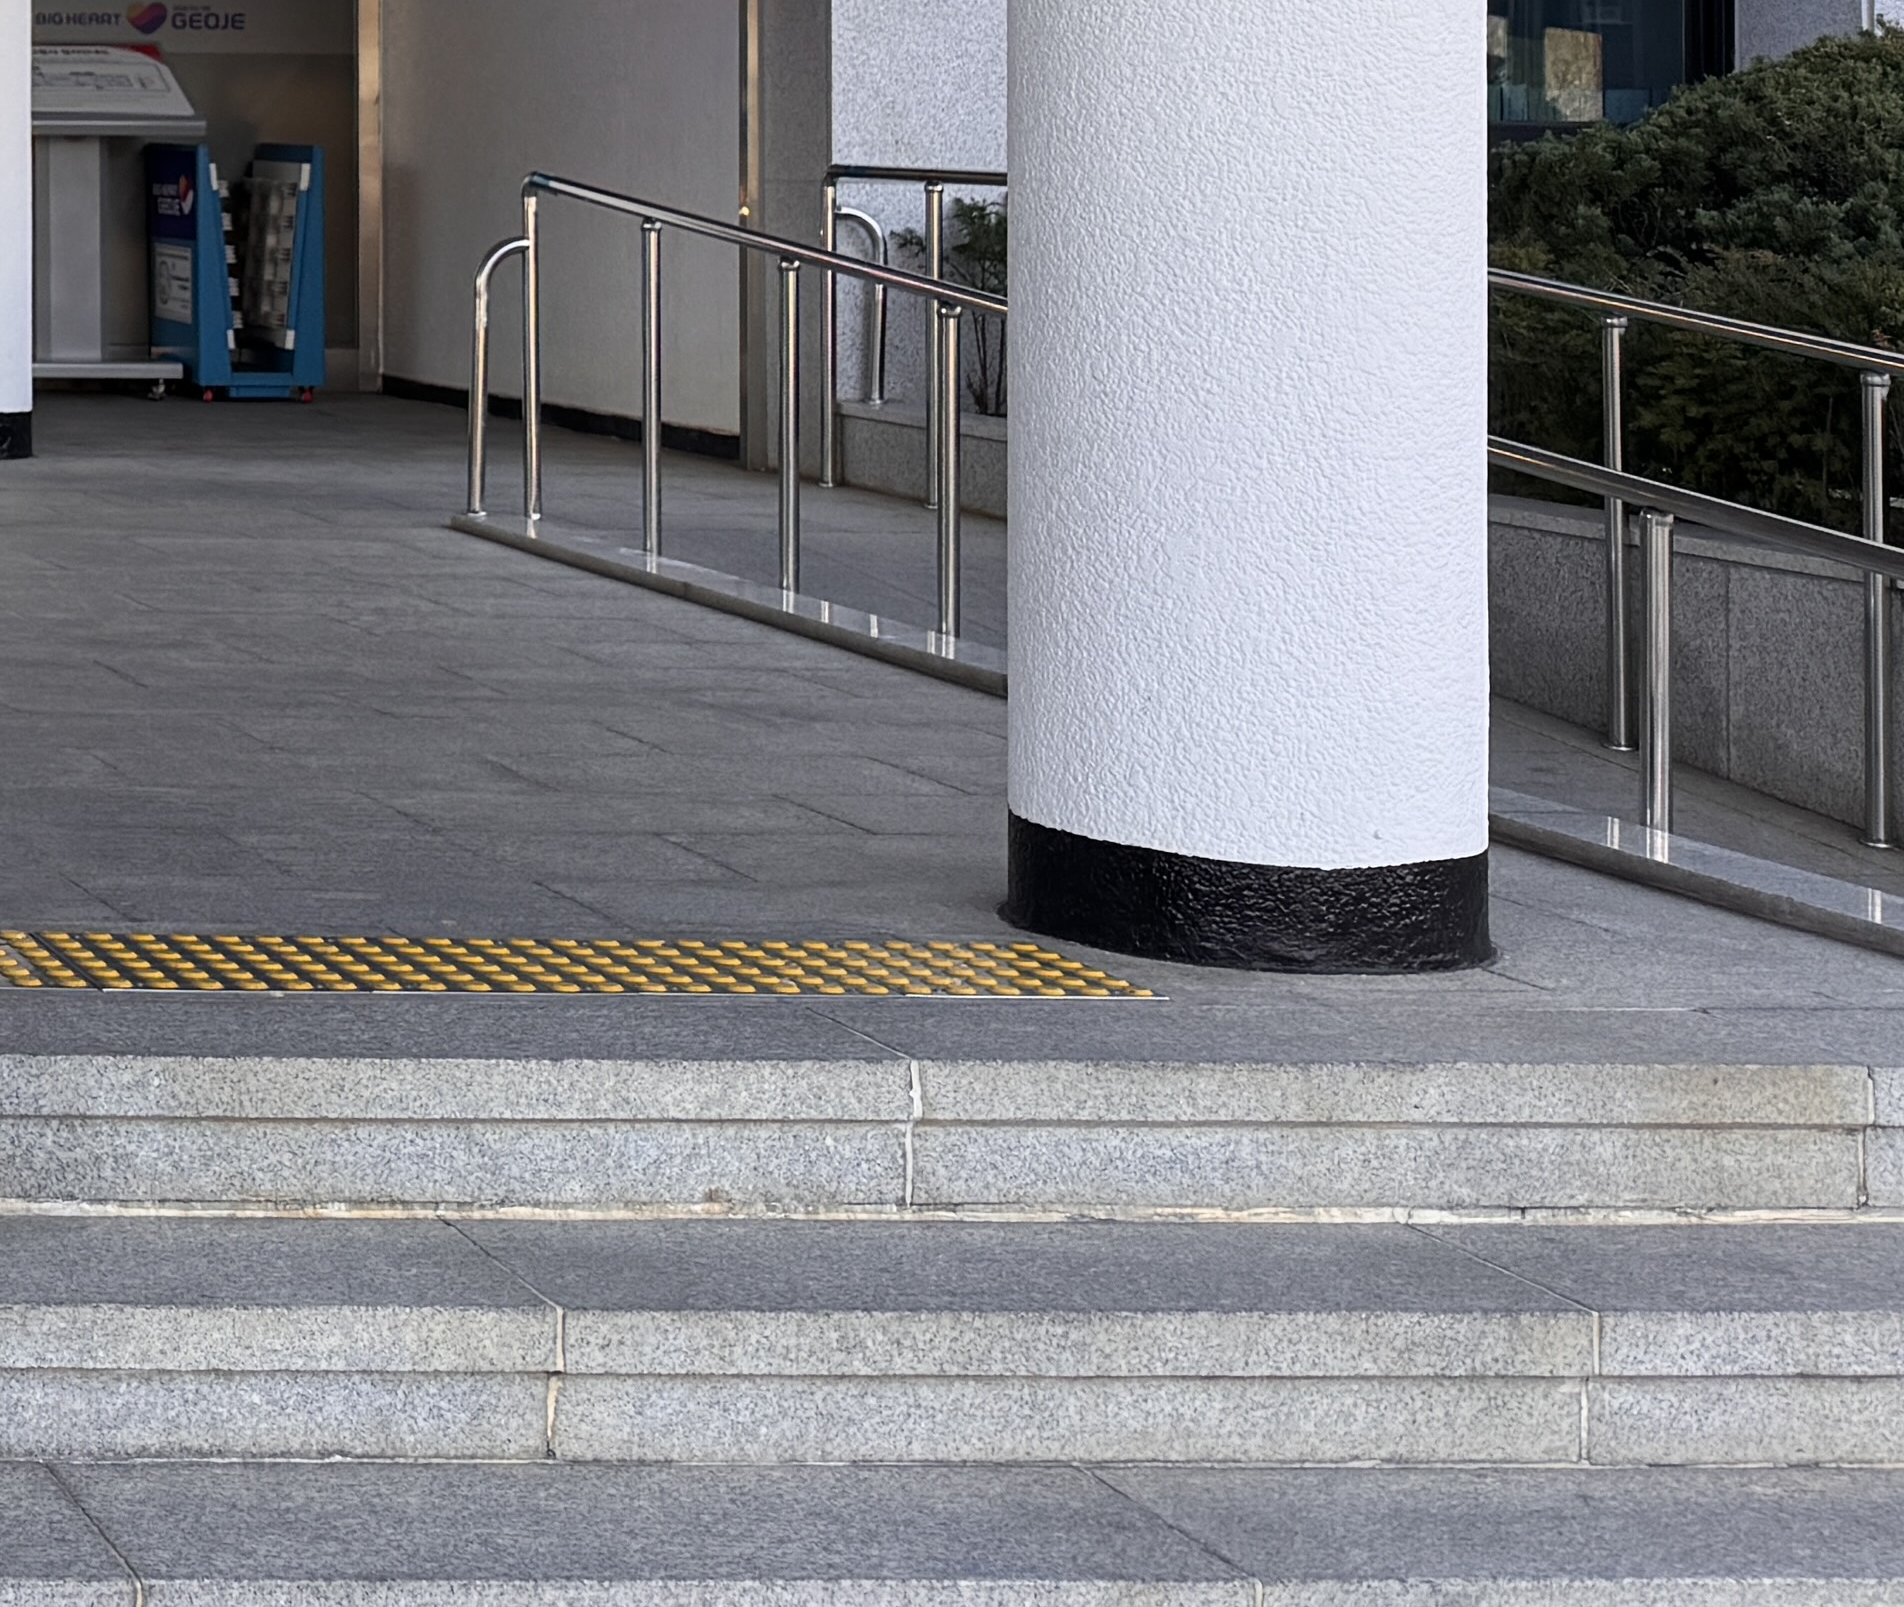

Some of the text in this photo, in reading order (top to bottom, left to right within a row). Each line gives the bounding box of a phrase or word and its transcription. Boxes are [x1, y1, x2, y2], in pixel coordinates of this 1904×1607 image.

[35, 12, 121, 26] BIG HEART
[171, 11, 246, 31] GEOJE
